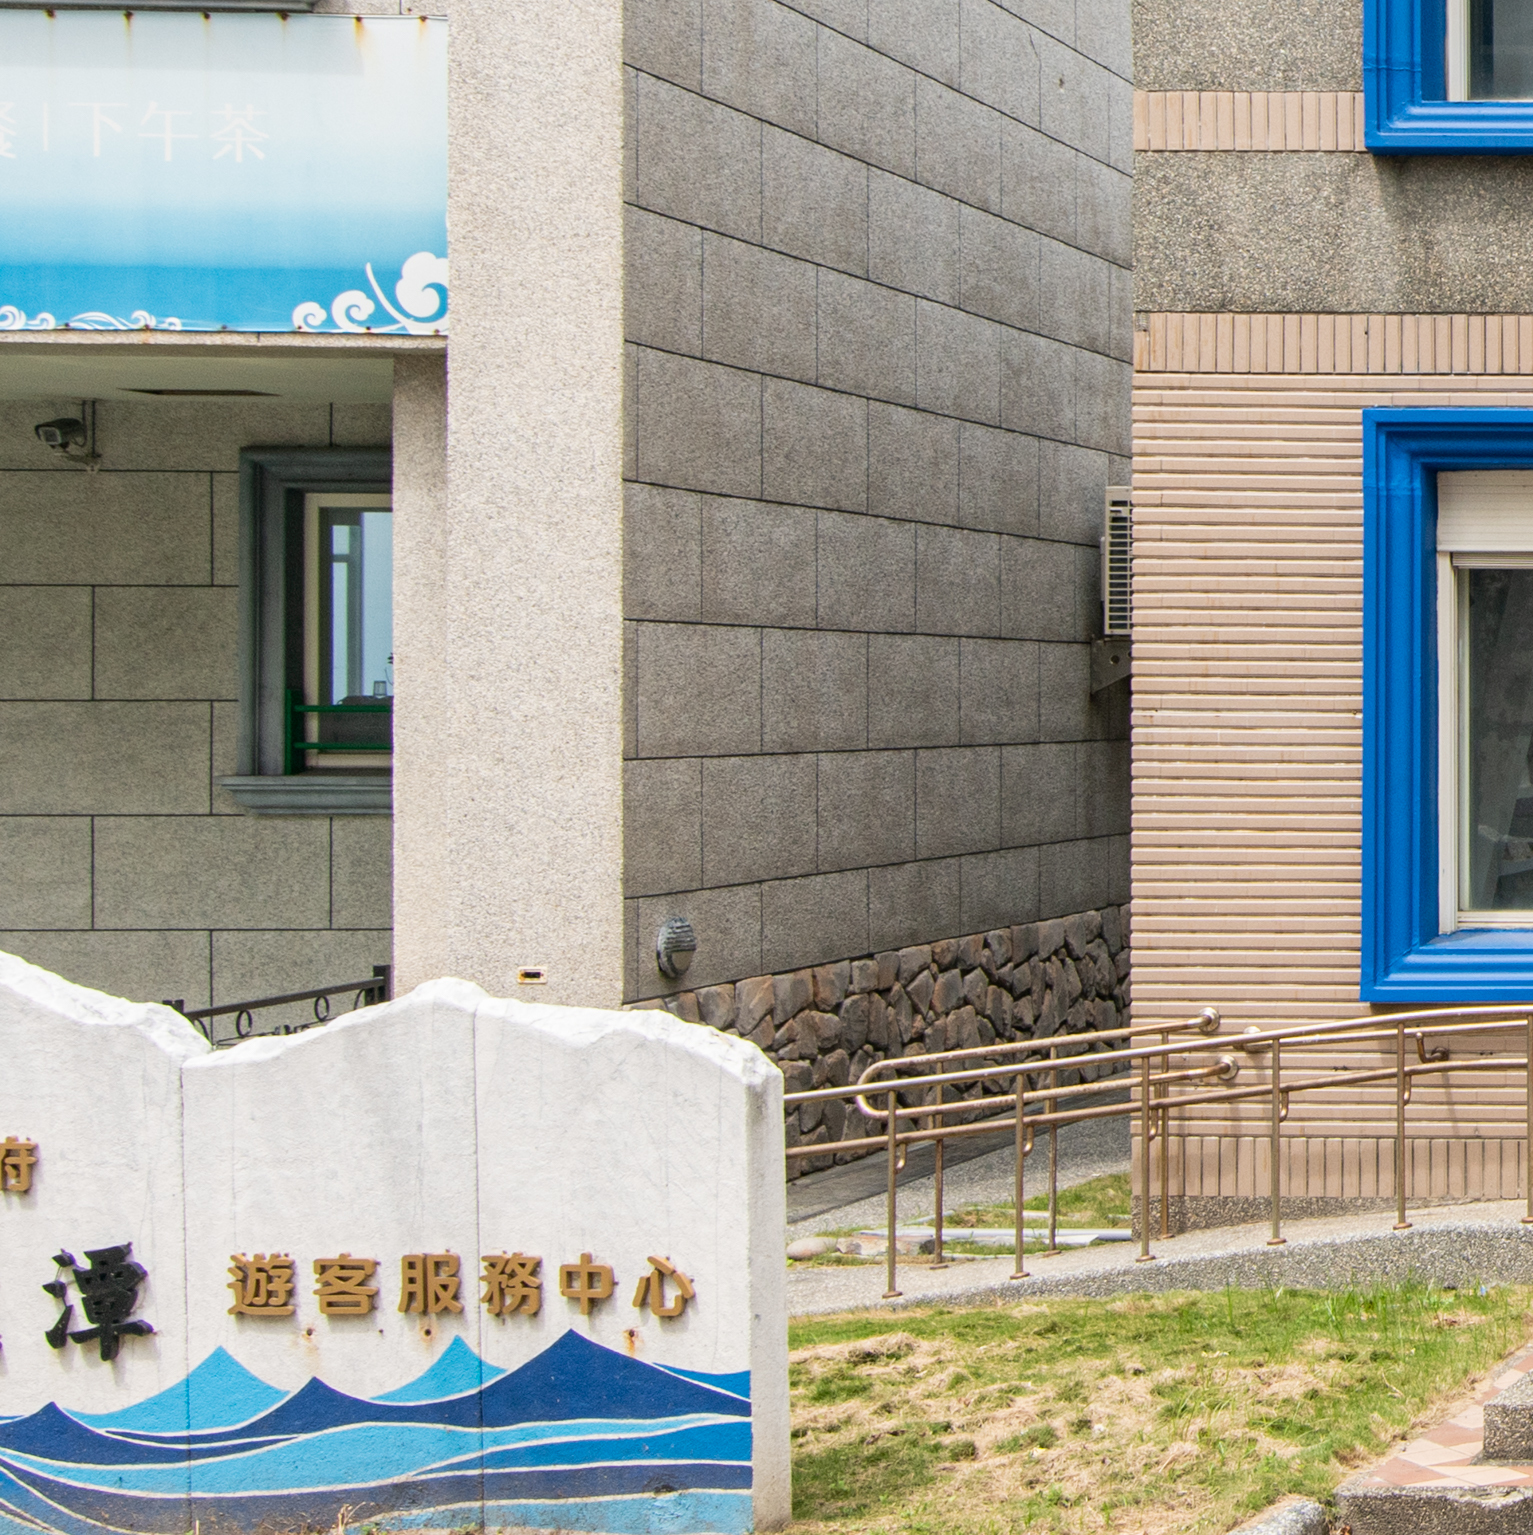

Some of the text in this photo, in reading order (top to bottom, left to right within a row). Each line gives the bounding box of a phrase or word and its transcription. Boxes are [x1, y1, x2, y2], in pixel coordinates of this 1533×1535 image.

[227, 1251, 696, 1318] 遊客服務中心
